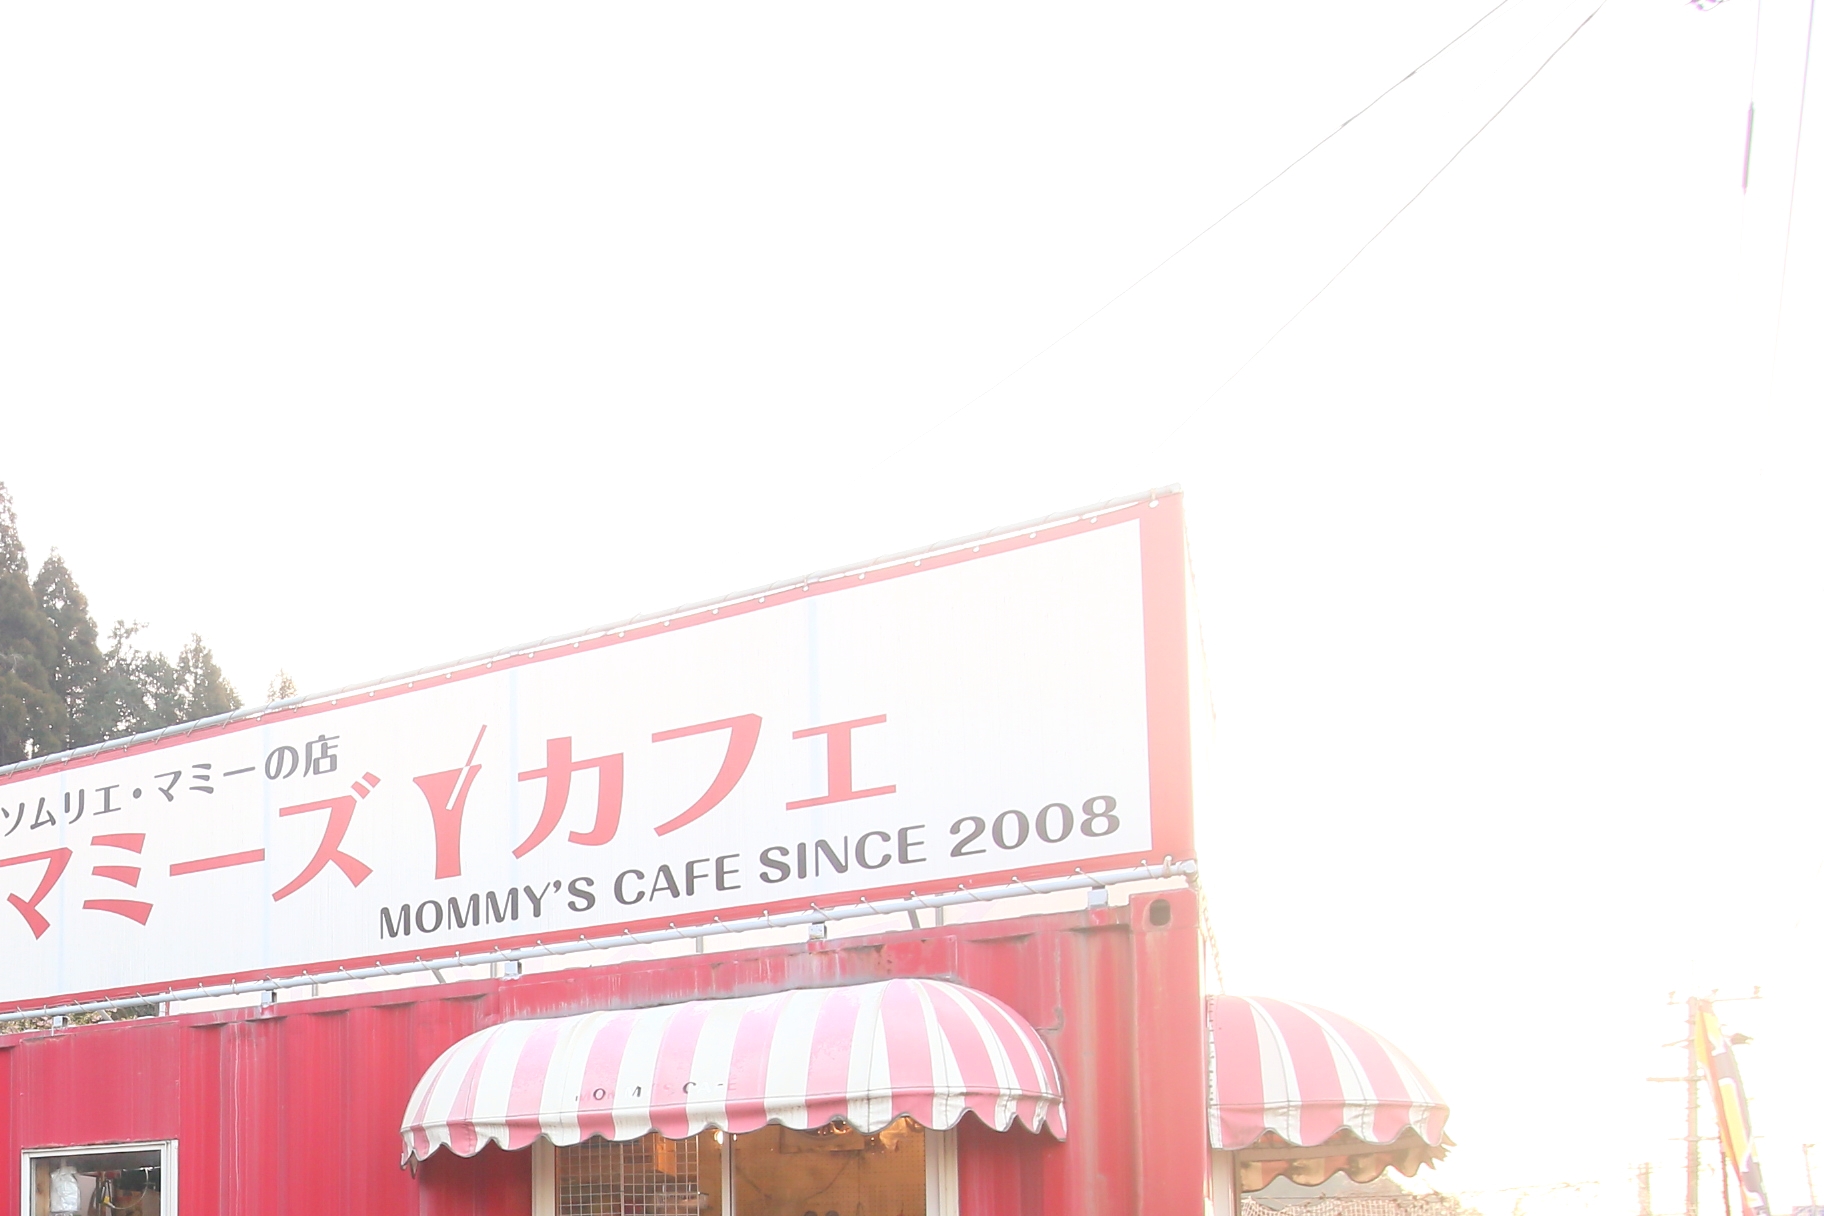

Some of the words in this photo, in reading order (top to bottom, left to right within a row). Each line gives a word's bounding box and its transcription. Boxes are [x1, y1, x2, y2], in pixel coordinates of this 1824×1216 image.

[379, 876, 596, 940] MOMMY'S
[613, 853, 742, 906] CAFE
[759, 824, 927, 884] SINCE
[948, 794, 1121, 859] 2008
